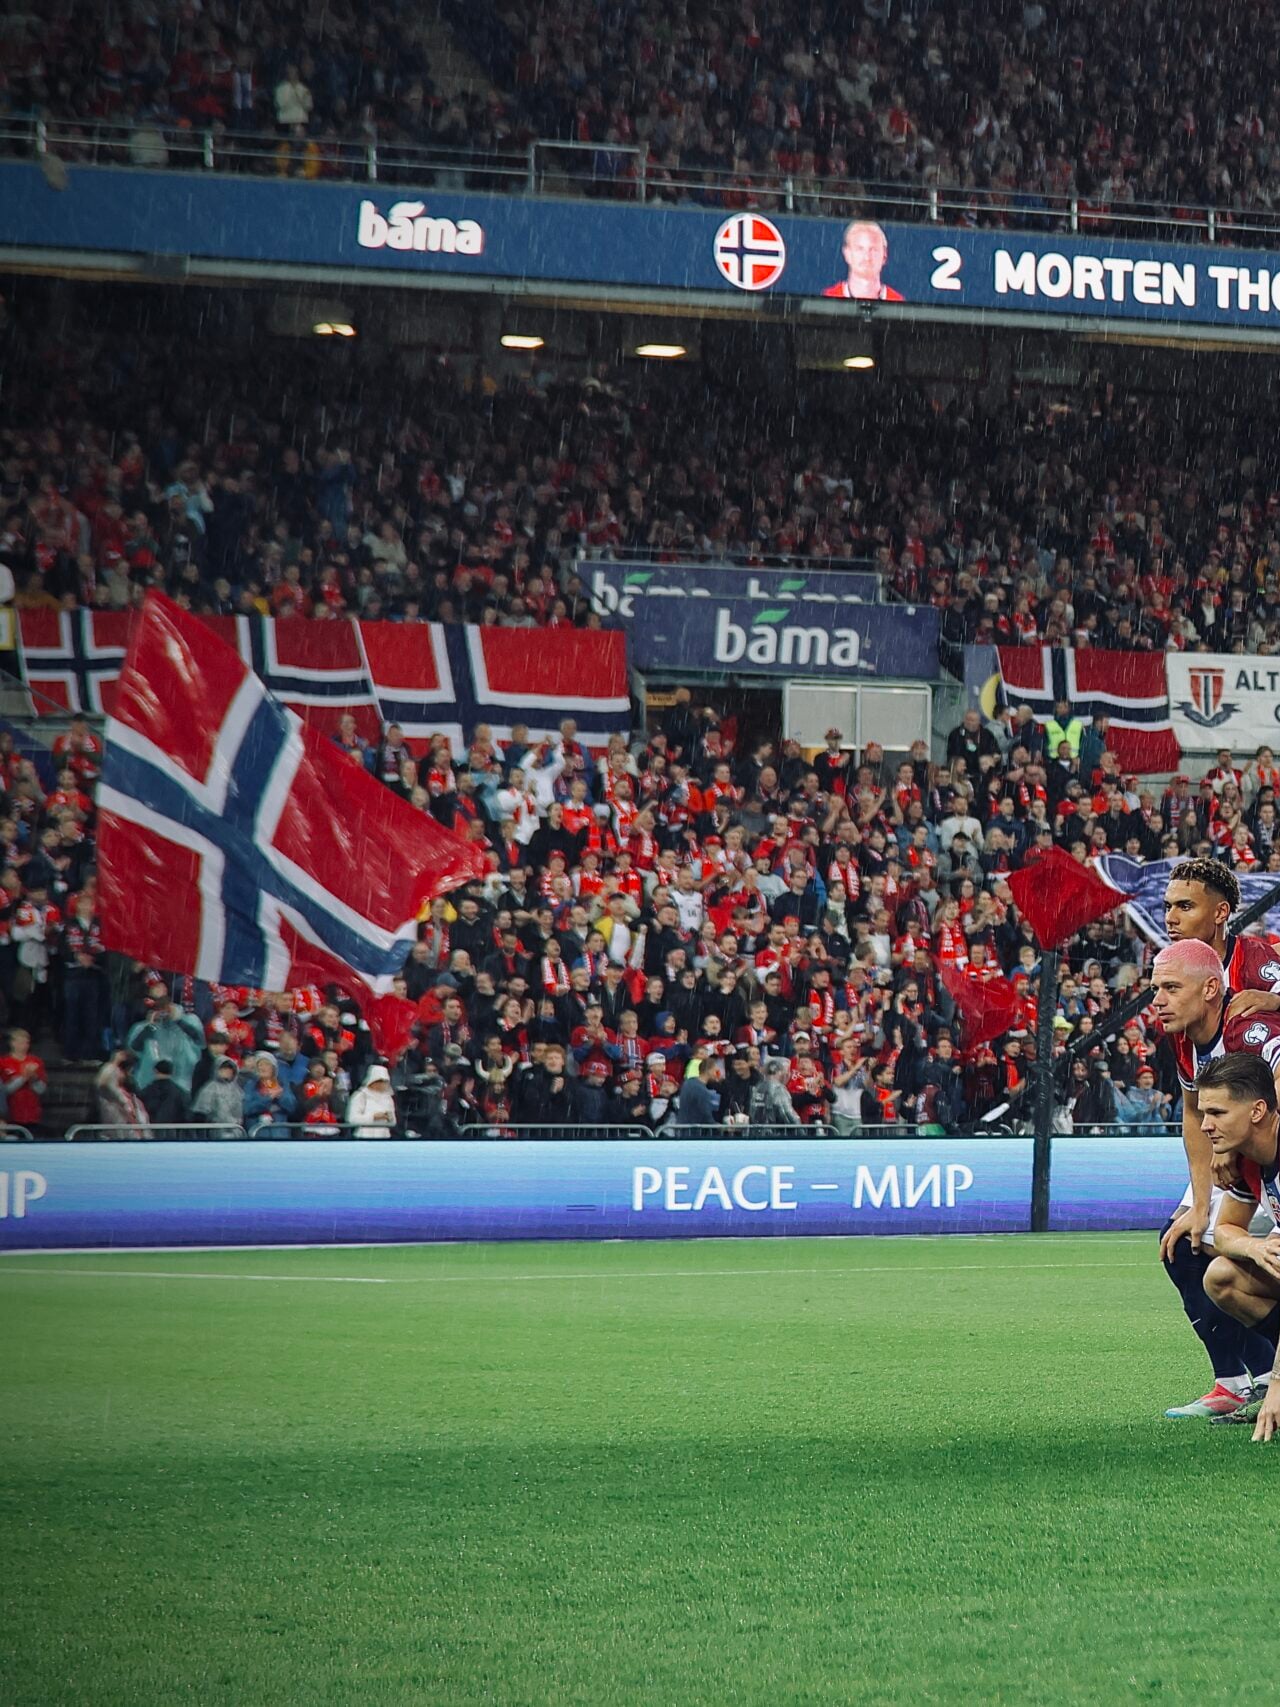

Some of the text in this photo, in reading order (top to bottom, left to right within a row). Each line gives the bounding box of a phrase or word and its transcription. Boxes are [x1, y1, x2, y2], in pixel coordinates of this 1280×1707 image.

[930, 246, 962, 291] 2
[994, 250, 1196, 307] MORTEN
[714, 608, 861, 668] bama
[1235, 670, 1279, 692] ALT
[632, 1164, 799, 1212] PEACE
[852, 1163, 974, 1209] МИР
